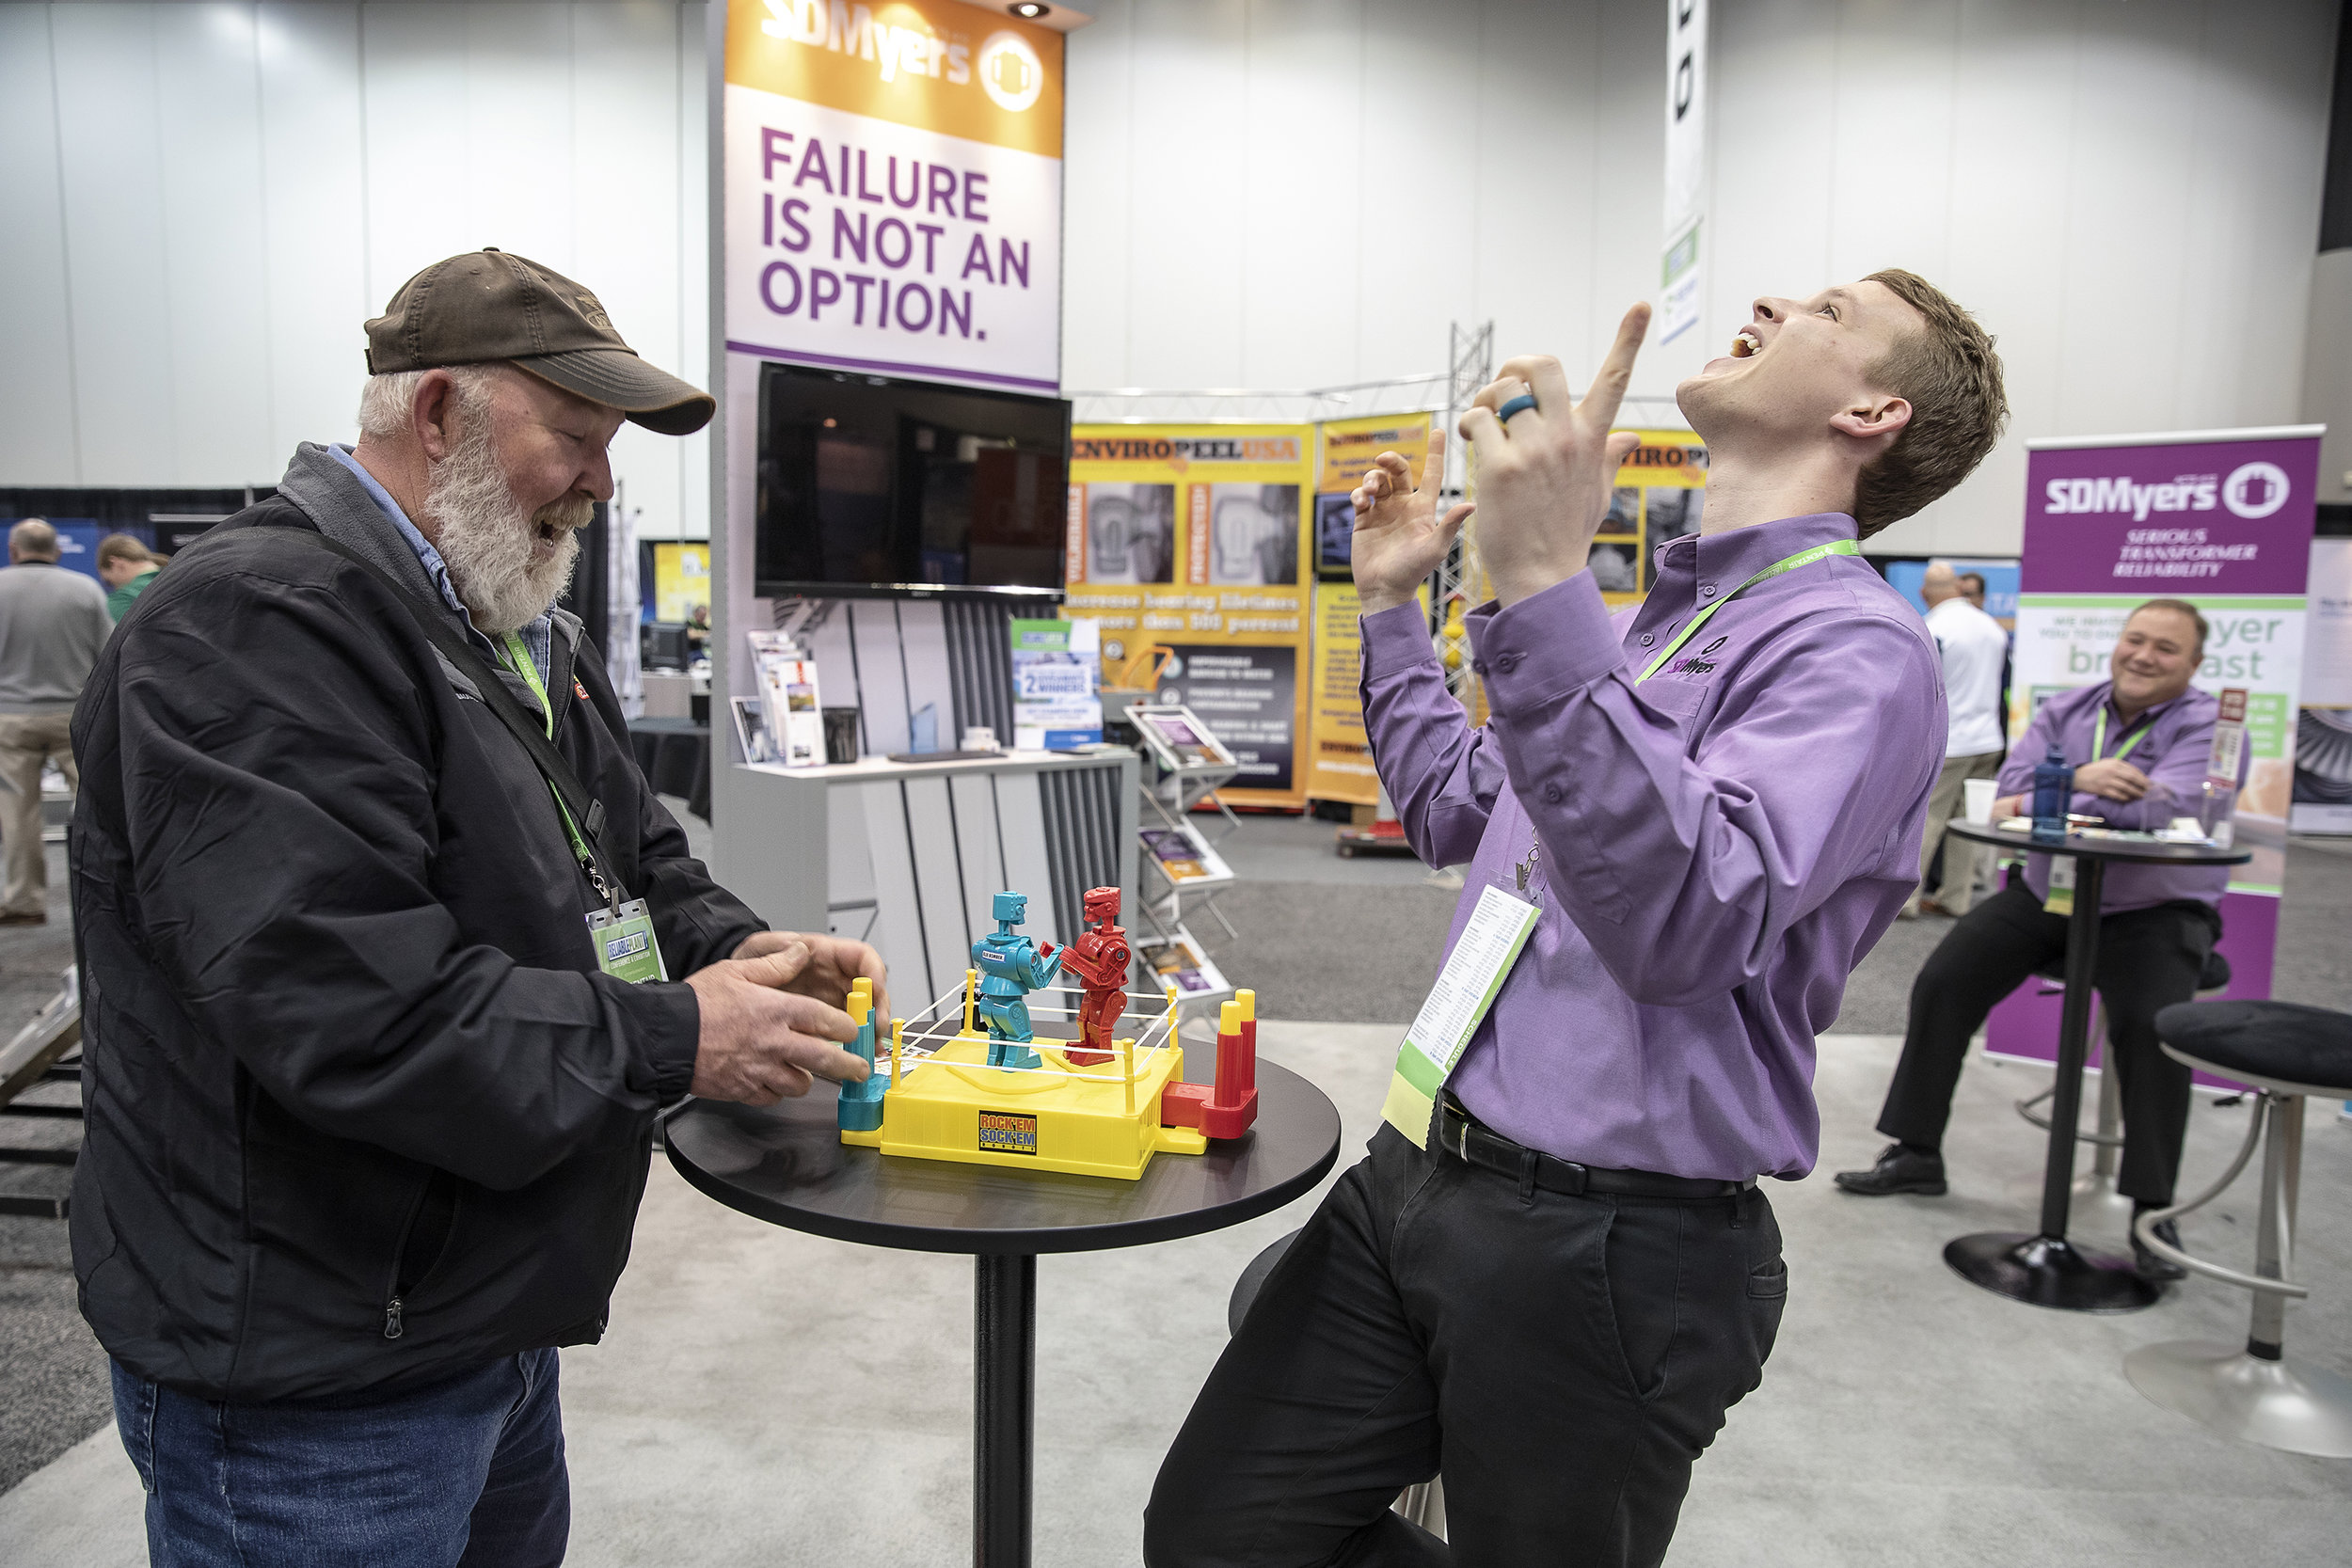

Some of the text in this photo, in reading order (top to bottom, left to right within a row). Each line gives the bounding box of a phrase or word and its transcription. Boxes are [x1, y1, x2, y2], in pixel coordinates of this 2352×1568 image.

[760, 126, 990, 224] FAILURE
[762, 192, 1030, 290] IS NOT AN
[758, 260, 987, 342] OPTION.
[2044, 477, 2218, 522] SDMyers
[2125, 528, 2209, 546] SERIOUS
[1788, 550, 1826, 569] PENTAIR
[2119, 545, 2258, 562] TRANSFORMER
[2112, 562, 2226, 578] RELIABILITY
[514, 646, 534, 676] PENTAIR
[1448, 1019, 1477, 1068] SCHEDULE
[979, 1115, 1035, 1132] ROCK'EM
[979, 1129, 1035, 1146] SOCK'EM
